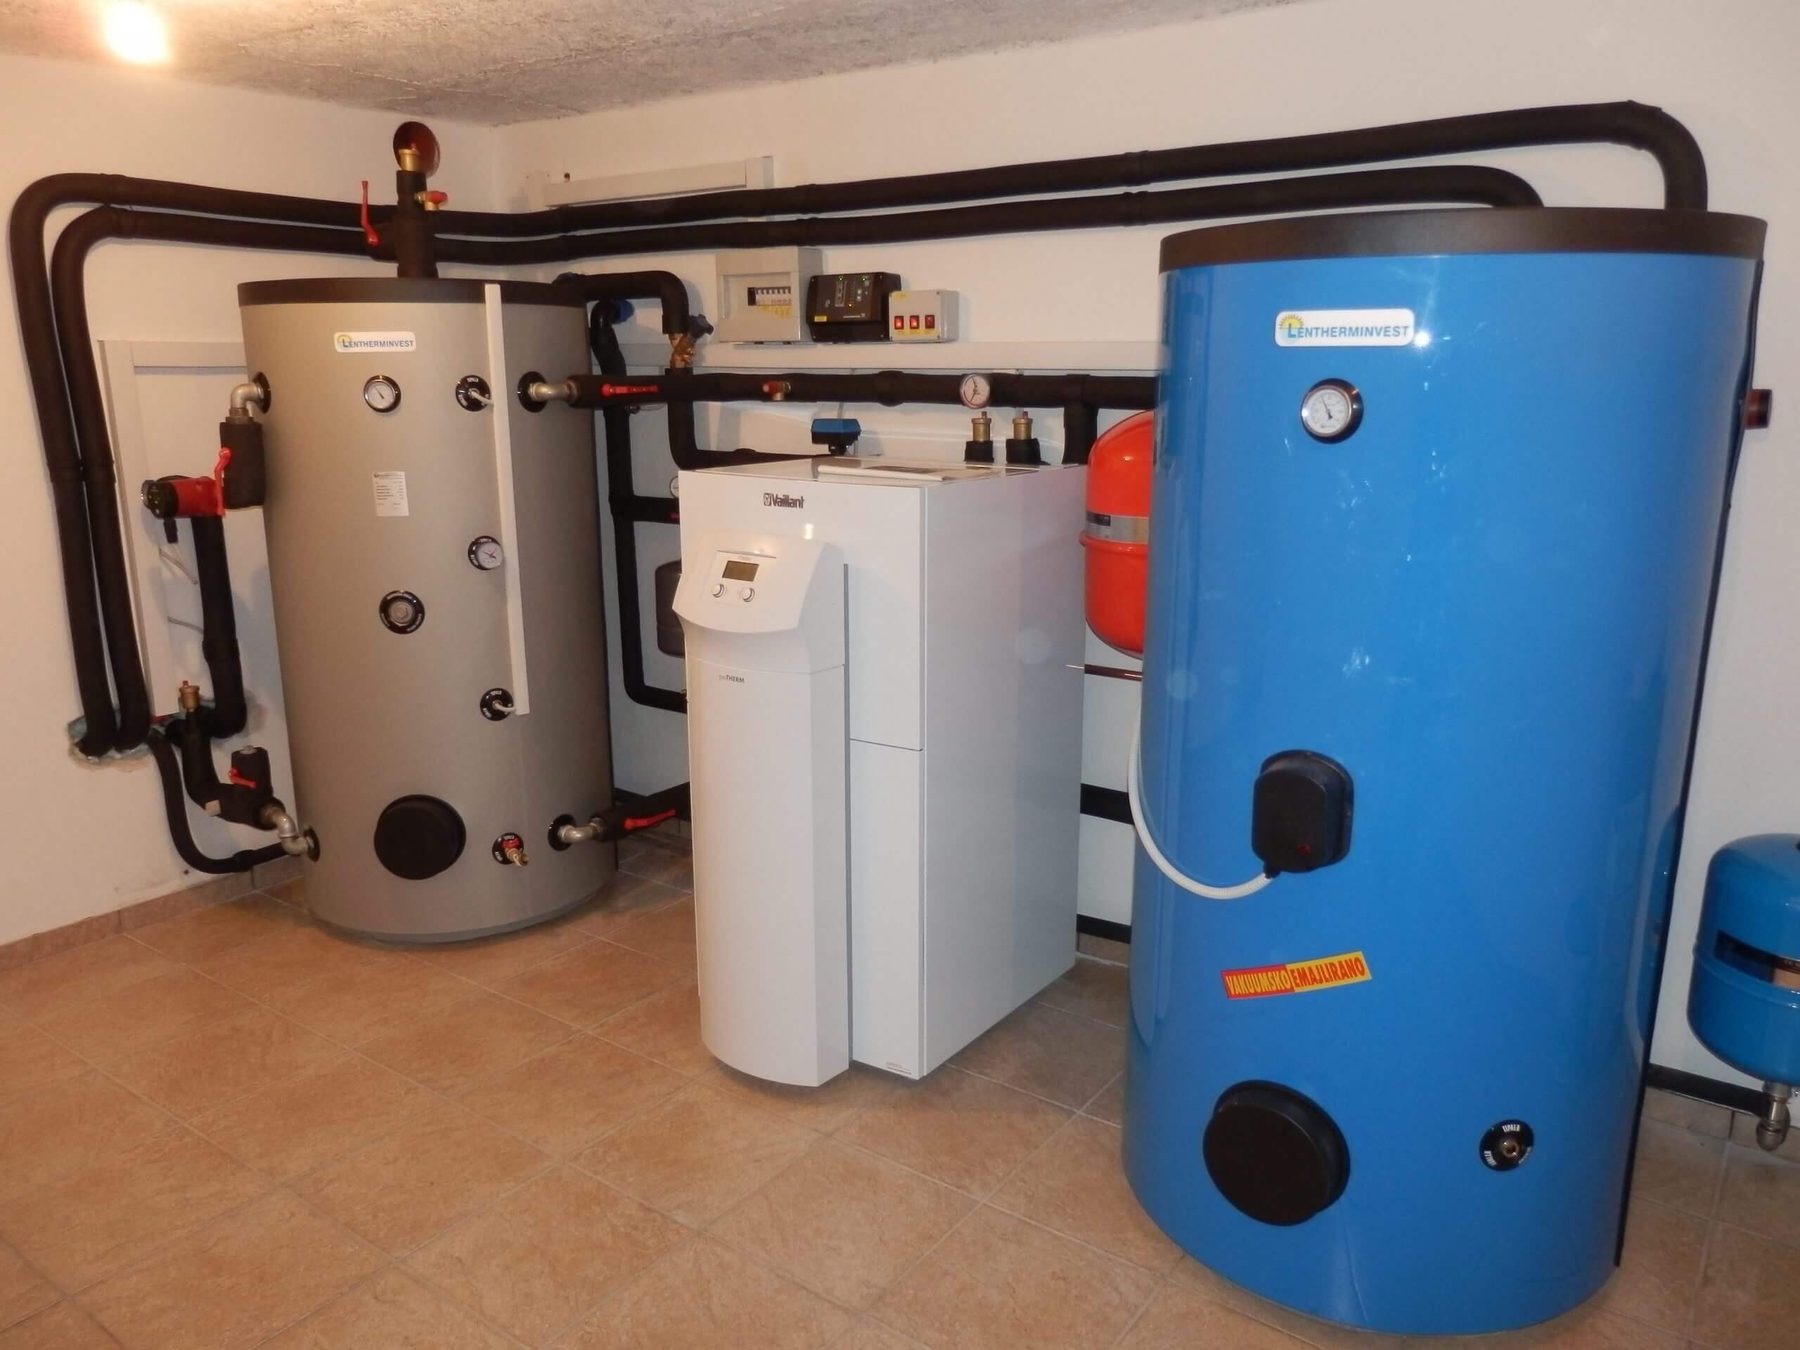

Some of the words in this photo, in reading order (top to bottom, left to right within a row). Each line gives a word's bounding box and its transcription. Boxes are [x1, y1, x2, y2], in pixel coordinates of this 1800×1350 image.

[1287, 322, 1409, 339] LENTHERMINVEST
[342, 338, 414, 348] LENTHERMINVEST
[772, 493, 805, 509] Vaillant
[1225, 969, 1292, 995] VAKUUMSKO
[1290, 956, 1366, 988] EMAJLIRANO
